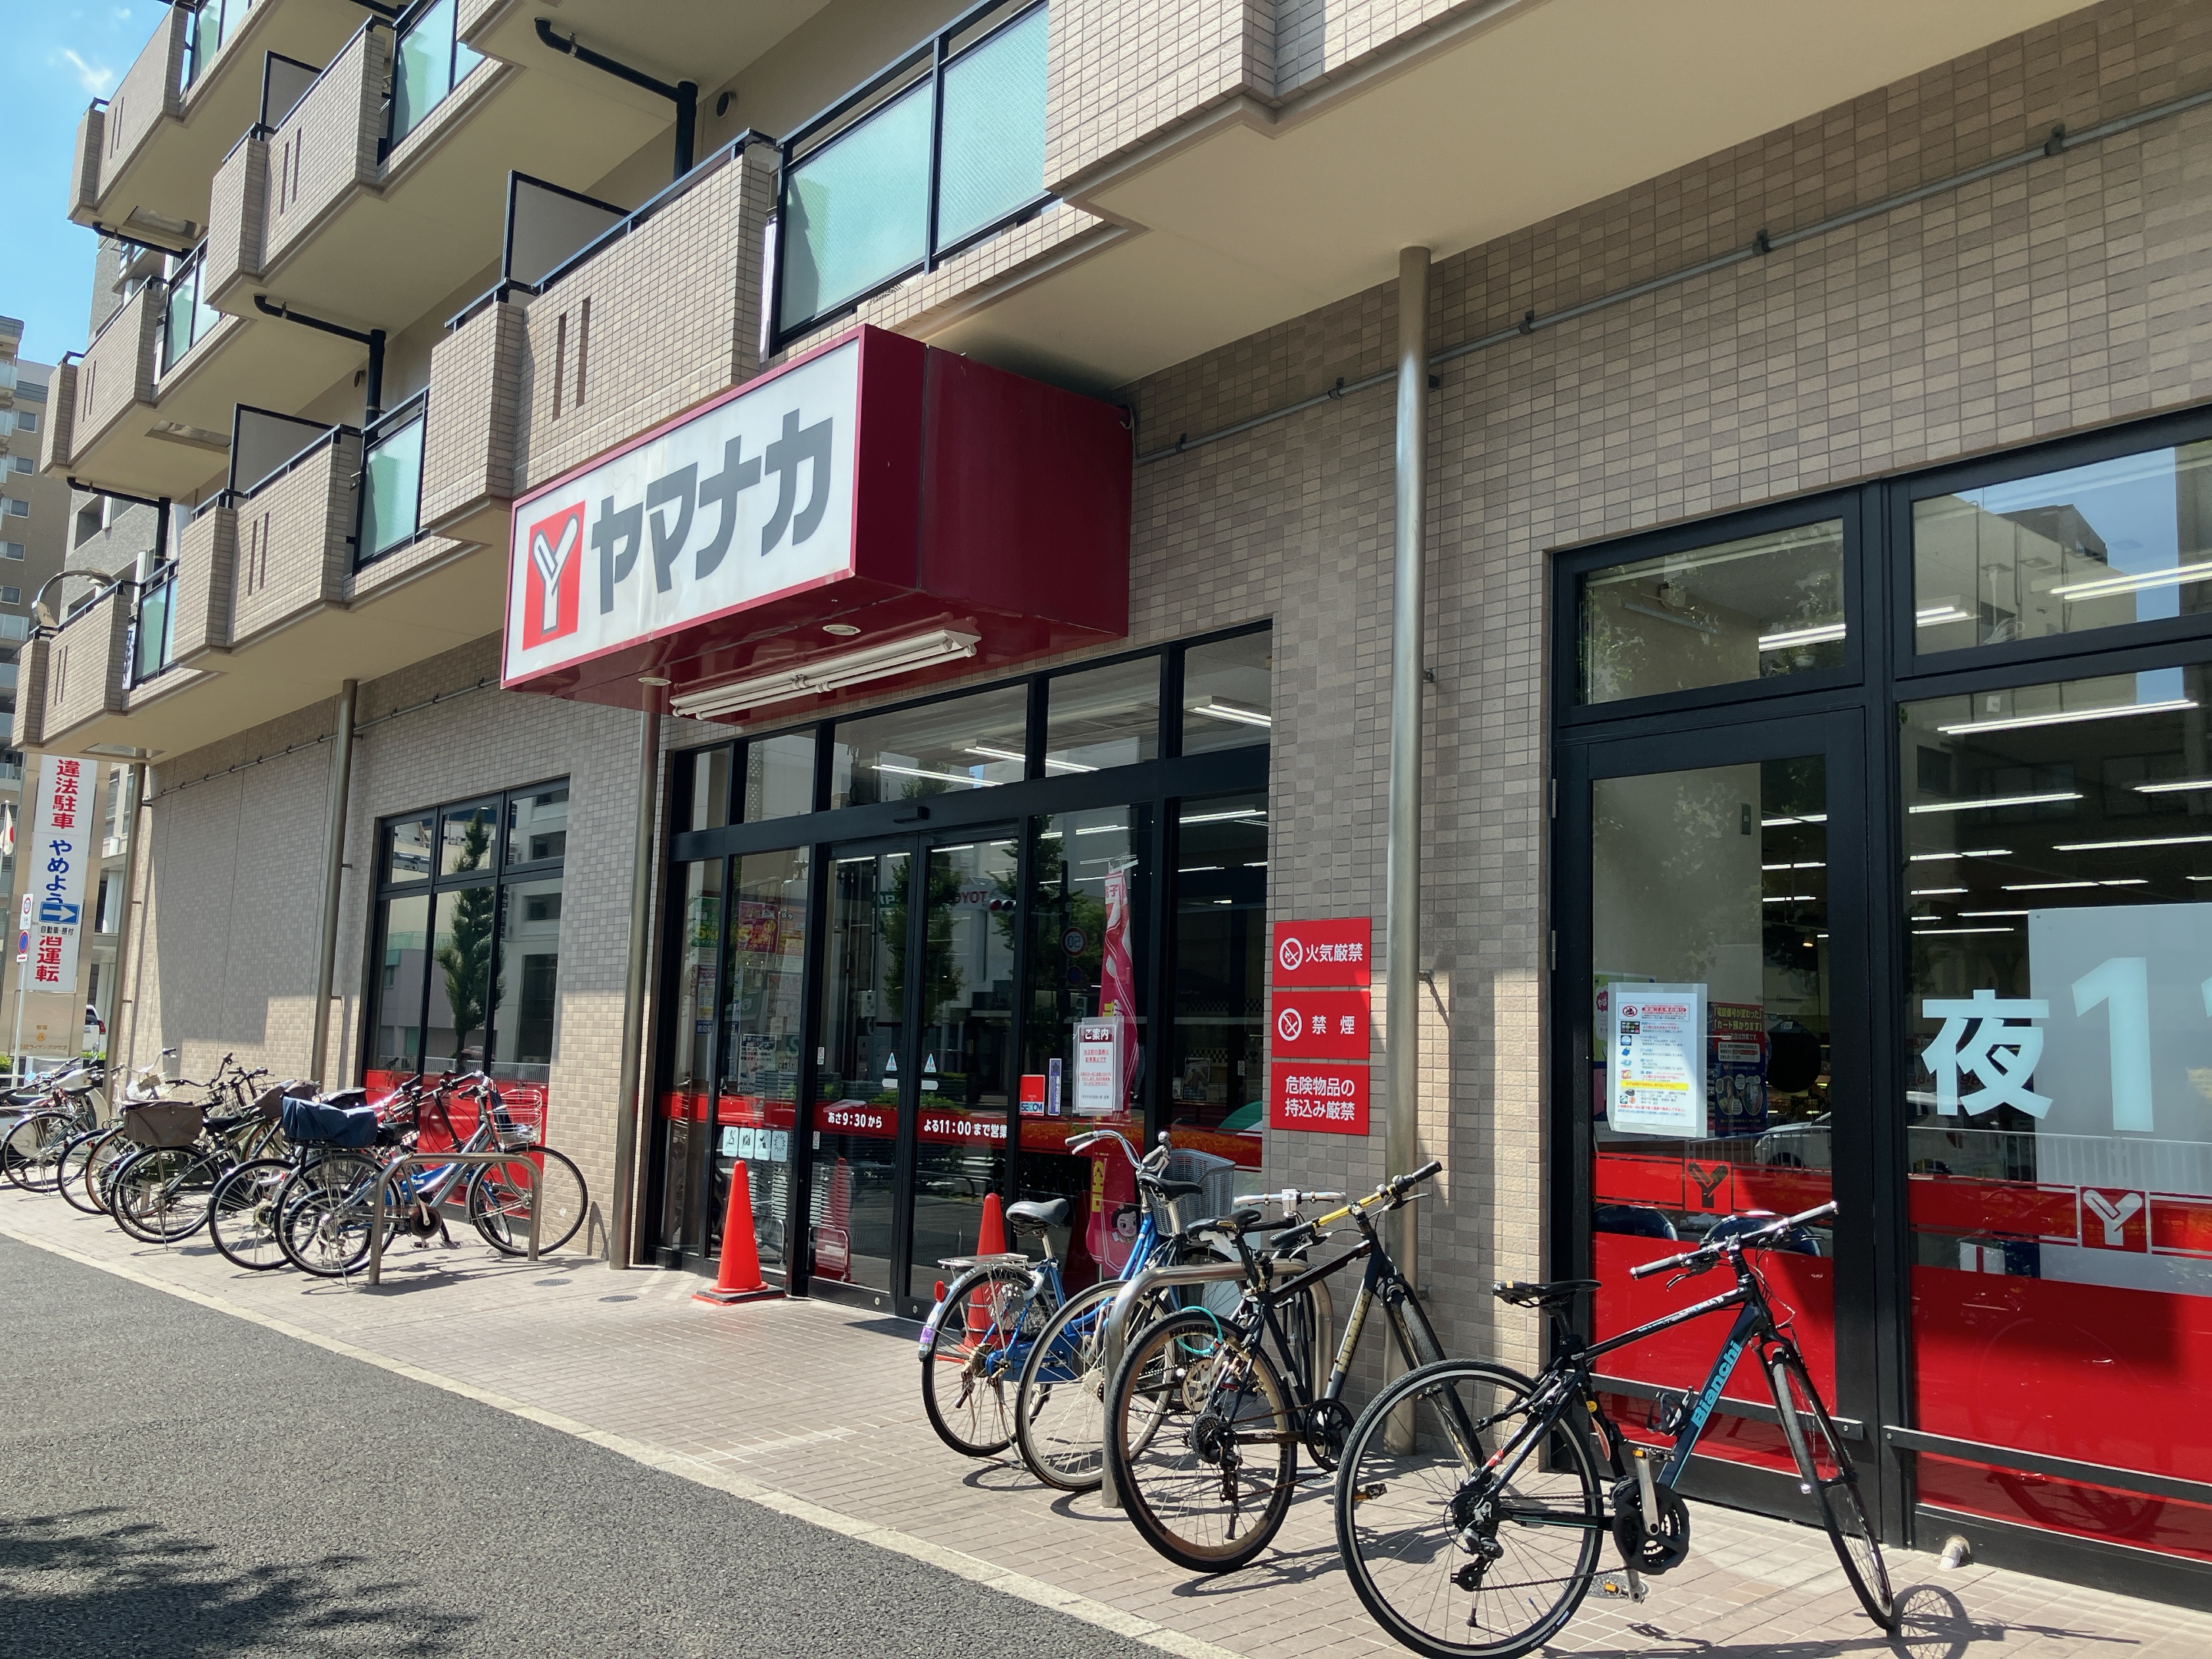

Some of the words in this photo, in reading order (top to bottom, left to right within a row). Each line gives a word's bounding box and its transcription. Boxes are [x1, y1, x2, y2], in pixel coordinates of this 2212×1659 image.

[591, 408, 833, 614] ヤマナカ
[51, 759, 81, 830] 違法駐車
[45, 839, 72, 904] やめよう
[40, 926, 75, 936] 自動車・原付
[1306, 942, 1363, 963] 火気厳禁
[35, 935, 62, 982] 酒運転
[1084, 1028, 1109, 1041] ご案内
[1921, 957, 2212, 1132] 夜1
[1021, 1103, 1043, 1111] SECOM
[1285, 1075, 1354, 1098] 危険物品の
[1284, 1101, 1355, 1121] 持込み厳禁
[1336, 1288, 1373, 1373] HUMMER
[1690, 1339, 1743, 1427] Bianchi
